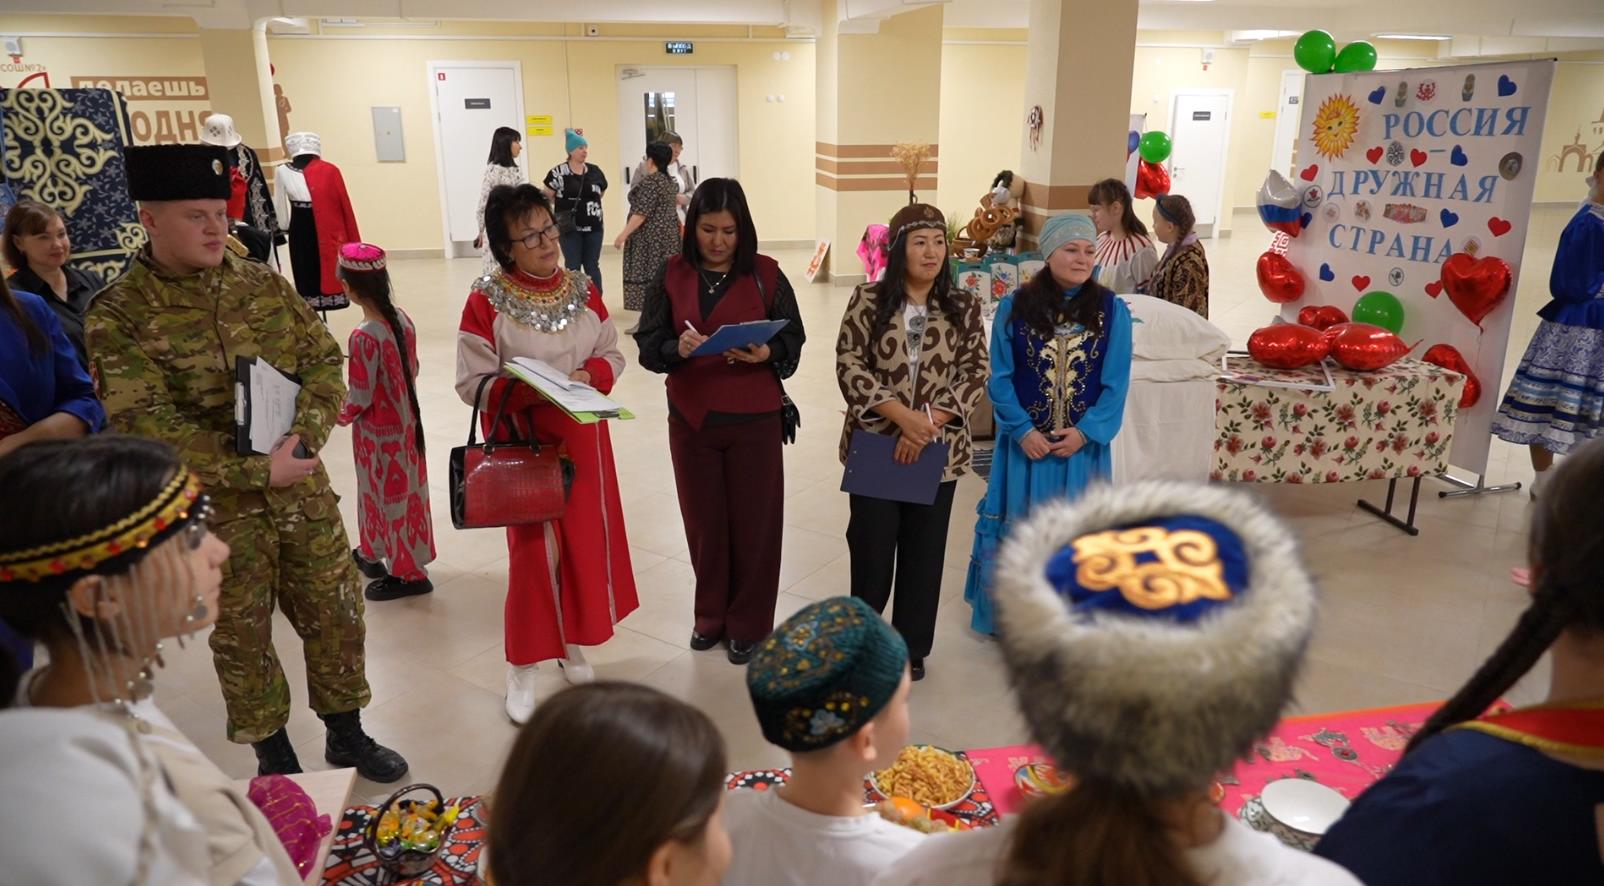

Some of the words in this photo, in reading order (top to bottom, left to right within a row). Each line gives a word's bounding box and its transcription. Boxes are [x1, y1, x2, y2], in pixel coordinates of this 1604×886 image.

[1383, 106, 1532, 140] РОССИЯ
[1327, 169, 1499, 203] ДРУЖНАЯ
[1329, 223, 1454, 264] СТРАНА
